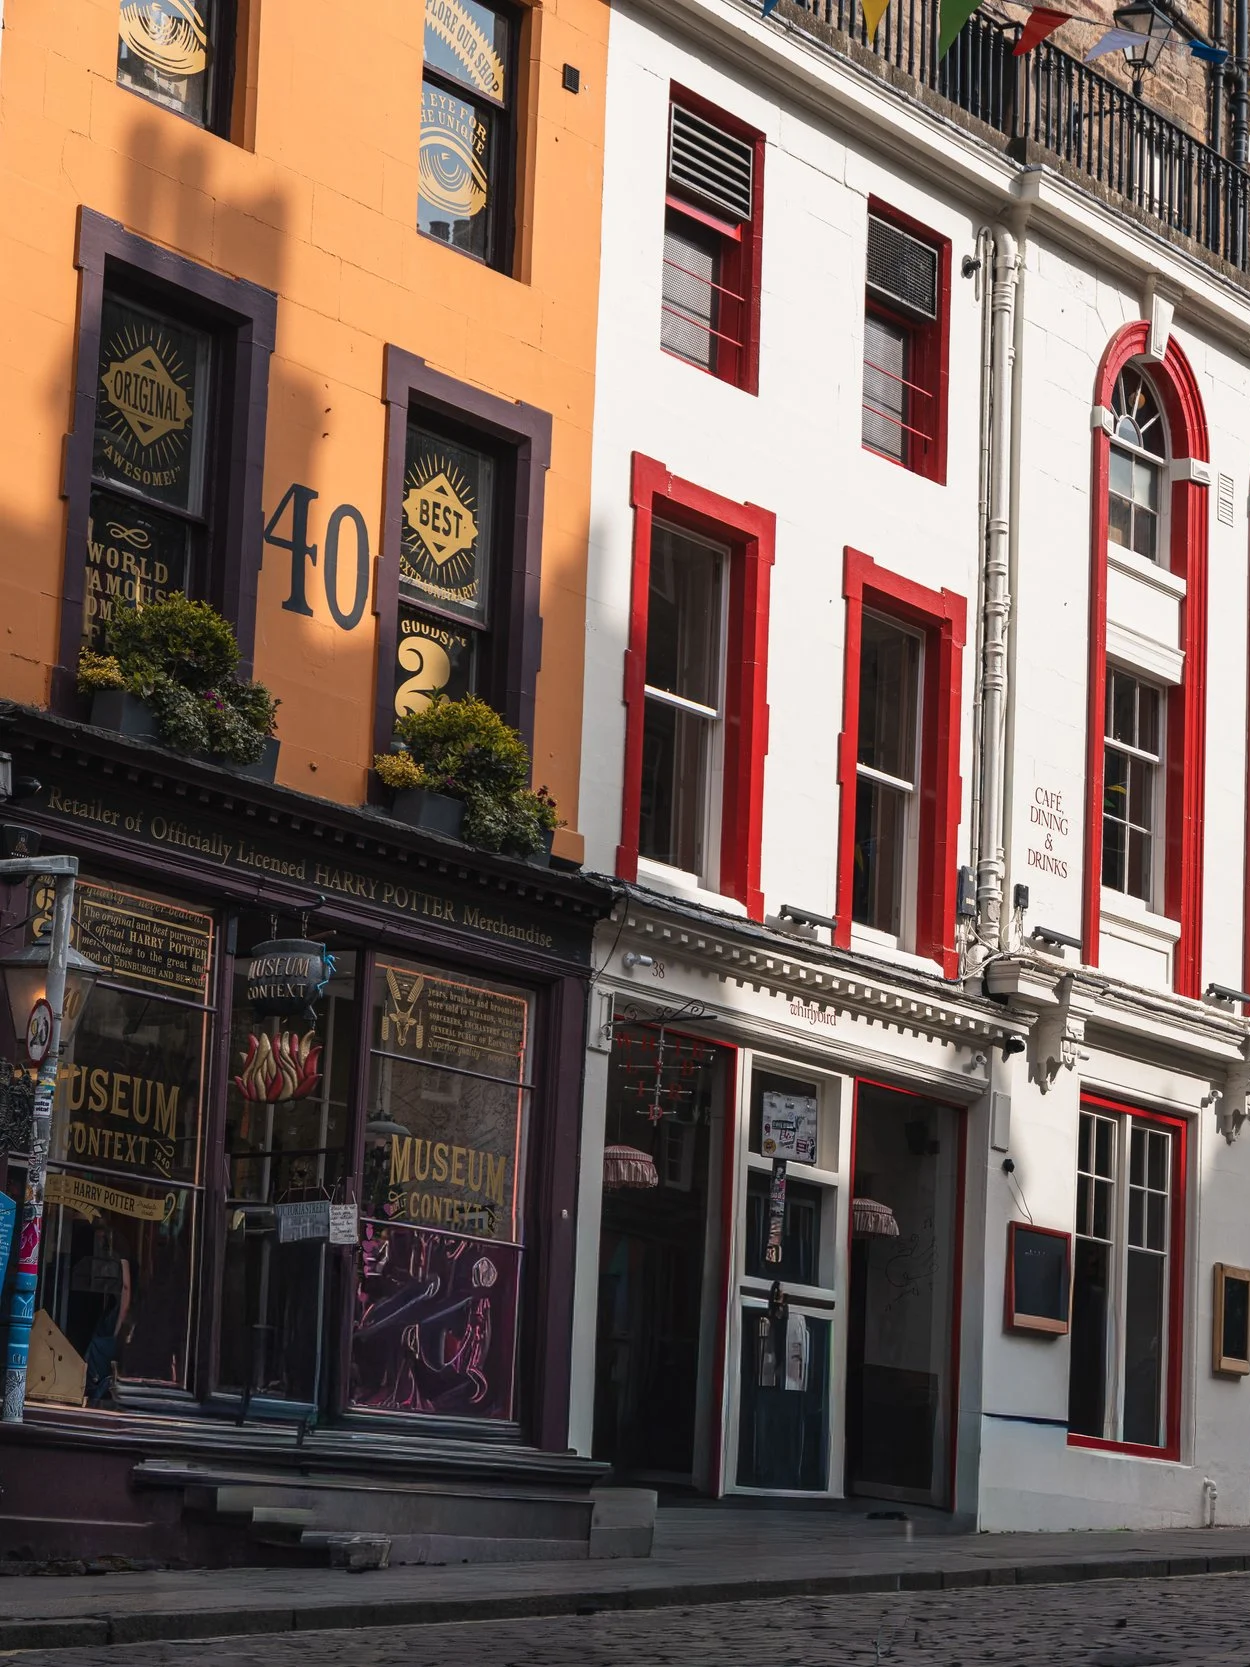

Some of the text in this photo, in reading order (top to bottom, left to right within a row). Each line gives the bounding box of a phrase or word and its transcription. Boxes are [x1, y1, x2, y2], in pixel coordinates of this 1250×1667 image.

[457, 24, 478, 60] OUR
[474, 52, 500, 93] SHOP
[430, 93, 487, 142] EYE FOR
[438, 111, 484, 156] UNIQUE
[114, 370, 181, 422] ORIGINAL
[419, 498, 463, 539] BEST
[87, 540, 168, 584] WORLD
[263, 482, 370, 631] 40
[1030, 805, 1068, 836] DINING
[1035, 787, 1064, 814] CAFÉ,
[1044, 833, 1053, 851] &
[48, 787, 552, 948] Retailer of Officially Licensed HARRY POTTER Merchandise
[1028, 848, 1068, 879] DRINKS
[82, 920, 207, 961] of official HARRY POTTER
[83, 904, 208, 950] The original and best purveyors
[81, 935, 207, 975] merchandise to the great and
[102, 953, 112, 965] of
[248, 957, 310, 981] MUSEUM
[652, 960, 665, 979] 38
[247, 983, 306, 1000] CONTEXT
[790, 1001, 837, 1026] whirlybird
[153, 1149, 170, 1170] 1840
[389, 1134, 507, 1205] MUSEUM
[73, 1180, 102, 1201] HARRY
[104, 1190, 135, 1213] POTTER
